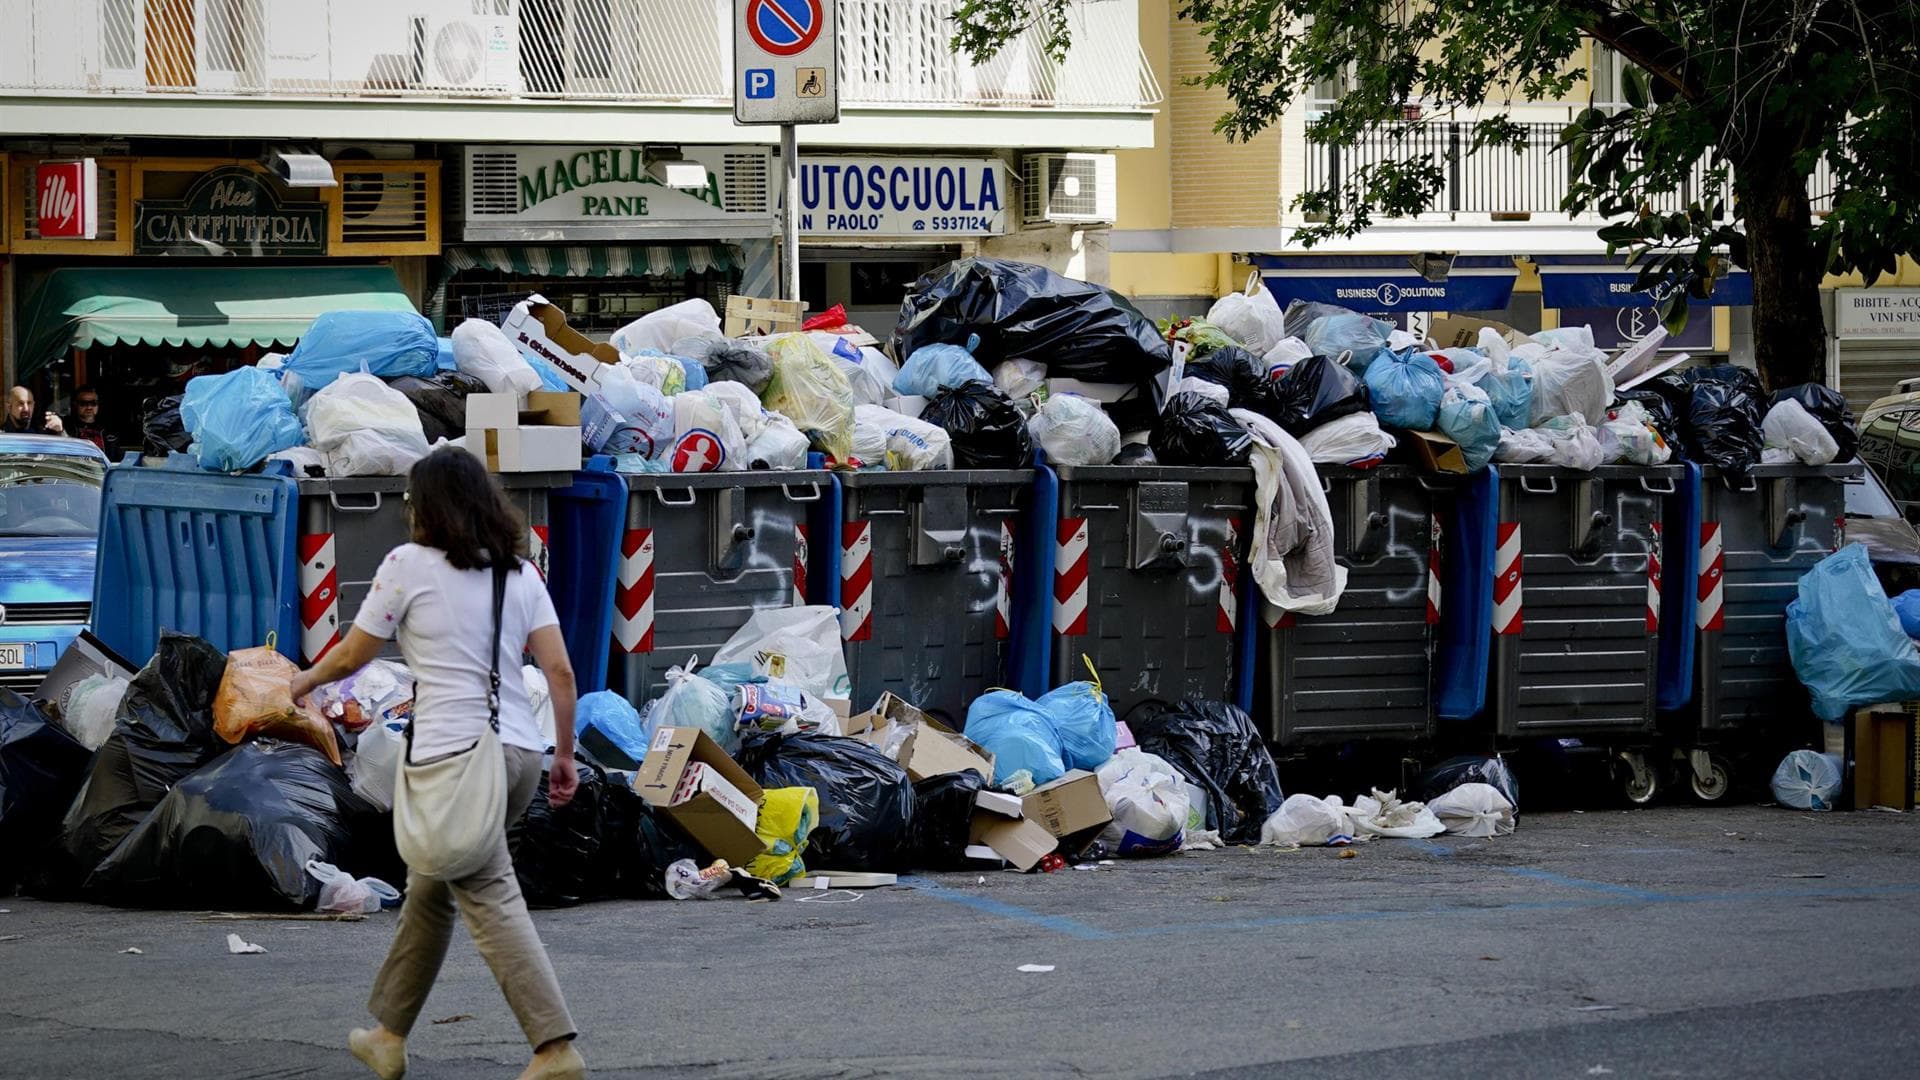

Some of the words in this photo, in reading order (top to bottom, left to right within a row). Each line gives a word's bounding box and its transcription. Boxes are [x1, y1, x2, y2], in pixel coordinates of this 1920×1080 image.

[751, 72, 769, 96] P
[518, 148, 724, 213] MACELLA
[777, 164, 999, 211] UTOSCUOLA
[40, 174, 76, 229] illy
[210, 180, 254, 210] Alex
[582, 195, 650, 216] PANE
[146, 215, 316, 243] CAFFETTERIA
[932, 216, 987, 230] 5937124
[1336, 288, 1377, 298] BUSINESS
[1400, 287, 1446, 298] SOLUTIONS
[1853, 297, 1890, 308] BIBITE
[1869, 312, 1894, 322] VINI
